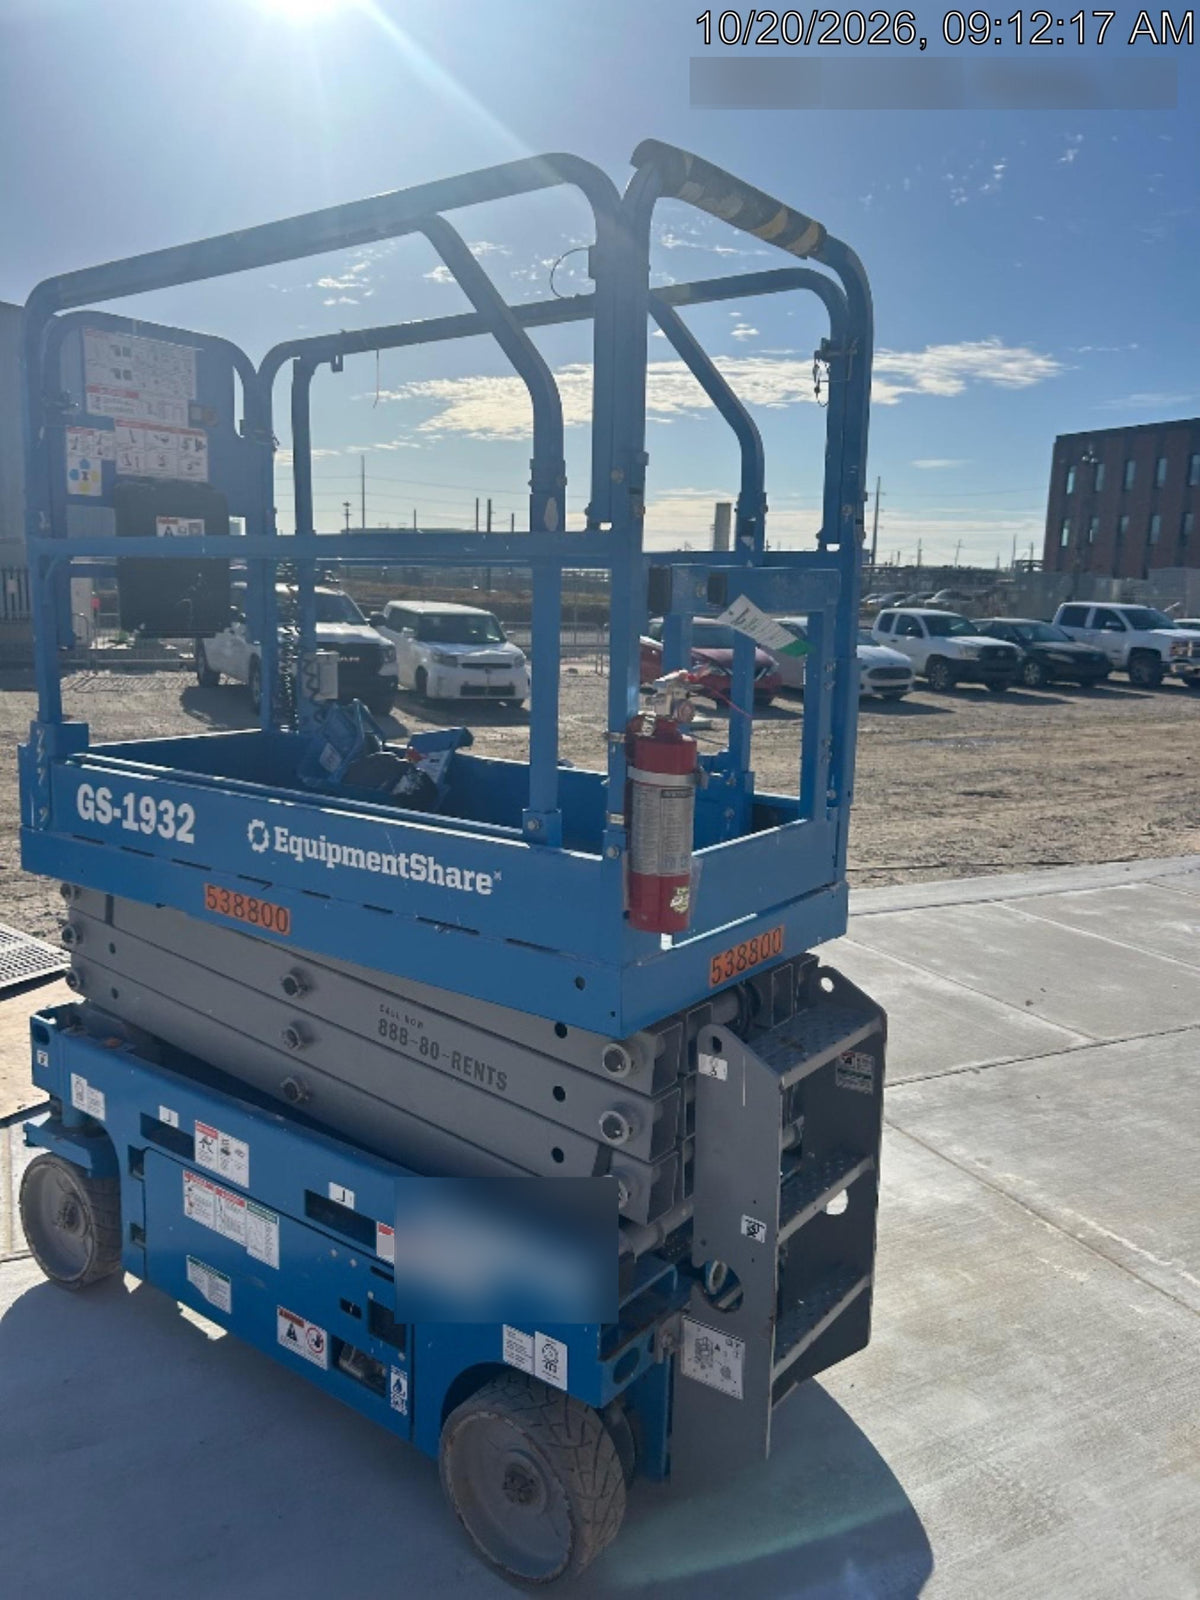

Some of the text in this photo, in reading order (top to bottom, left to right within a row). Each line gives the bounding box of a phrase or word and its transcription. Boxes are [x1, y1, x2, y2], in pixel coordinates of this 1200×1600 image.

[77, 783, 196, 845] GS-1932
[274, 826, 493, 896] EquipmentShare
[205, 883, 290, 934] 538800
[711, 926, 783, 985] 538800
[377, 1017, 508, 1092] 888-80-RENTS
